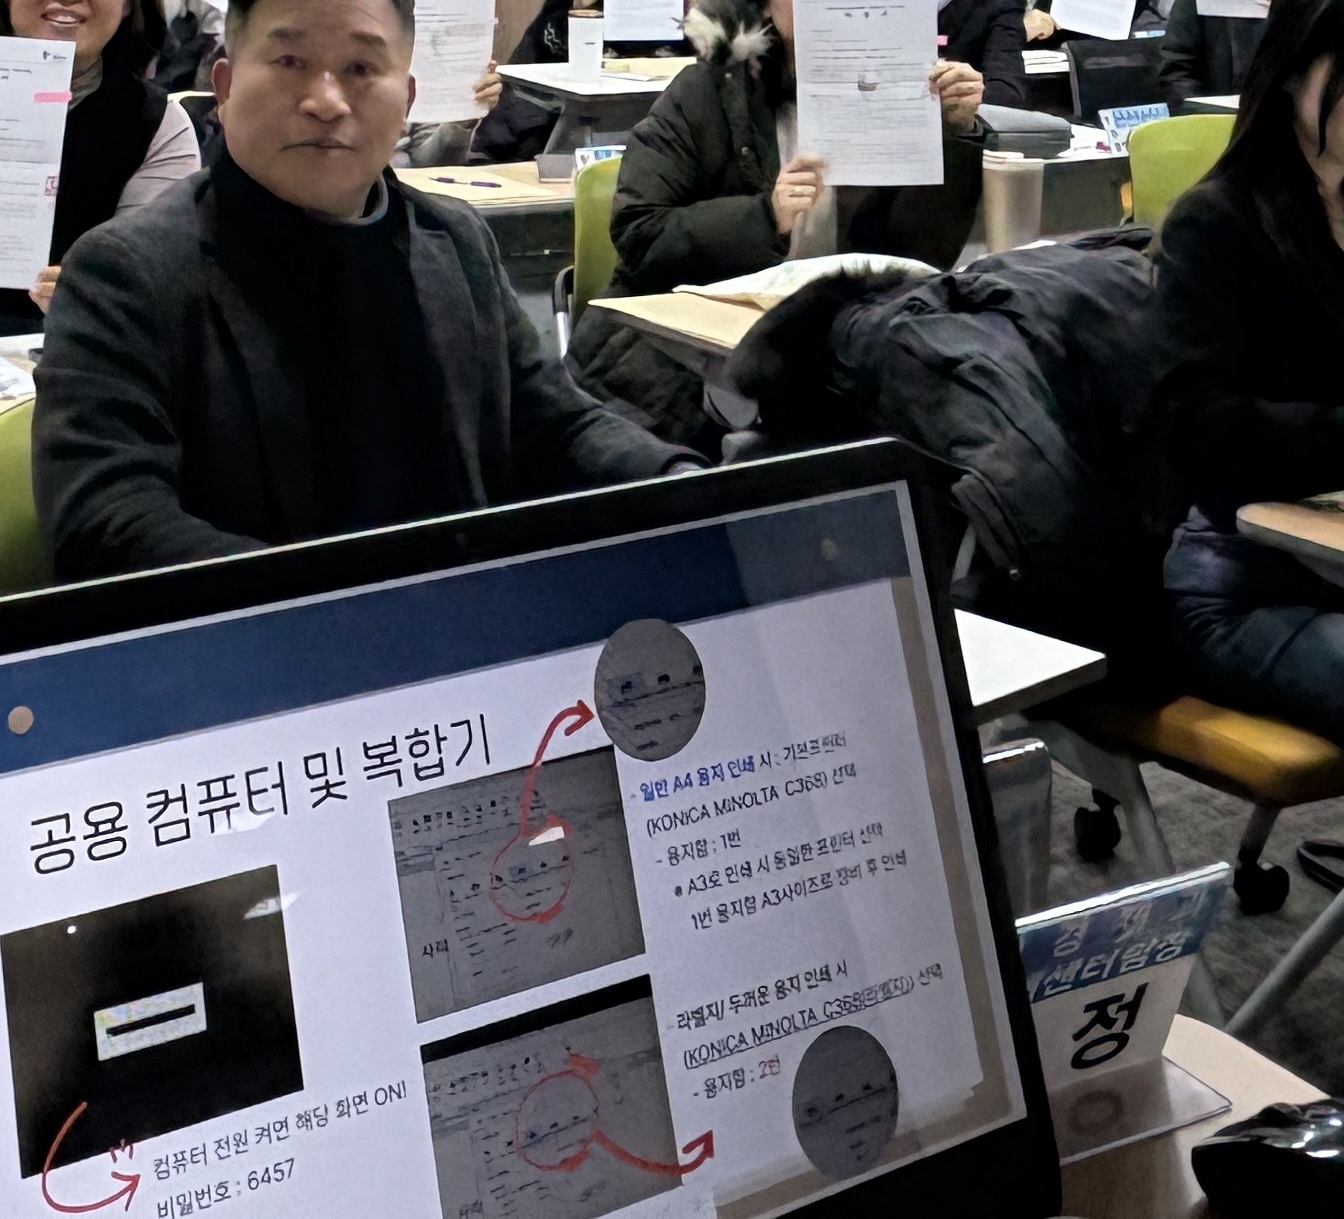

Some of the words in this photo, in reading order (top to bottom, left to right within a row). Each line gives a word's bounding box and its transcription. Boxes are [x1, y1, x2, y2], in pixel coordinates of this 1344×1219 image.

[29, 800, 129, 875] 공용
[146, 760, 289, 847] 컴퓨터
[303, 746, 348, 808] 및
[361, 713, 491, 787] 복합기
[646, 803, 712, 839] (KONICA
[1070, 981, 1150, 1070] 정
[152, 1142, 208, 1181] 컴퓨터
[213, 1129, 249, 1162] 전원
[254, 1116, 291, 1146] 켜면
[335, 1090, 370, 1120] 화면
[156, 1180, 232, 1219] 비밀번호
[246, 1157, 296, 1192] 6457
